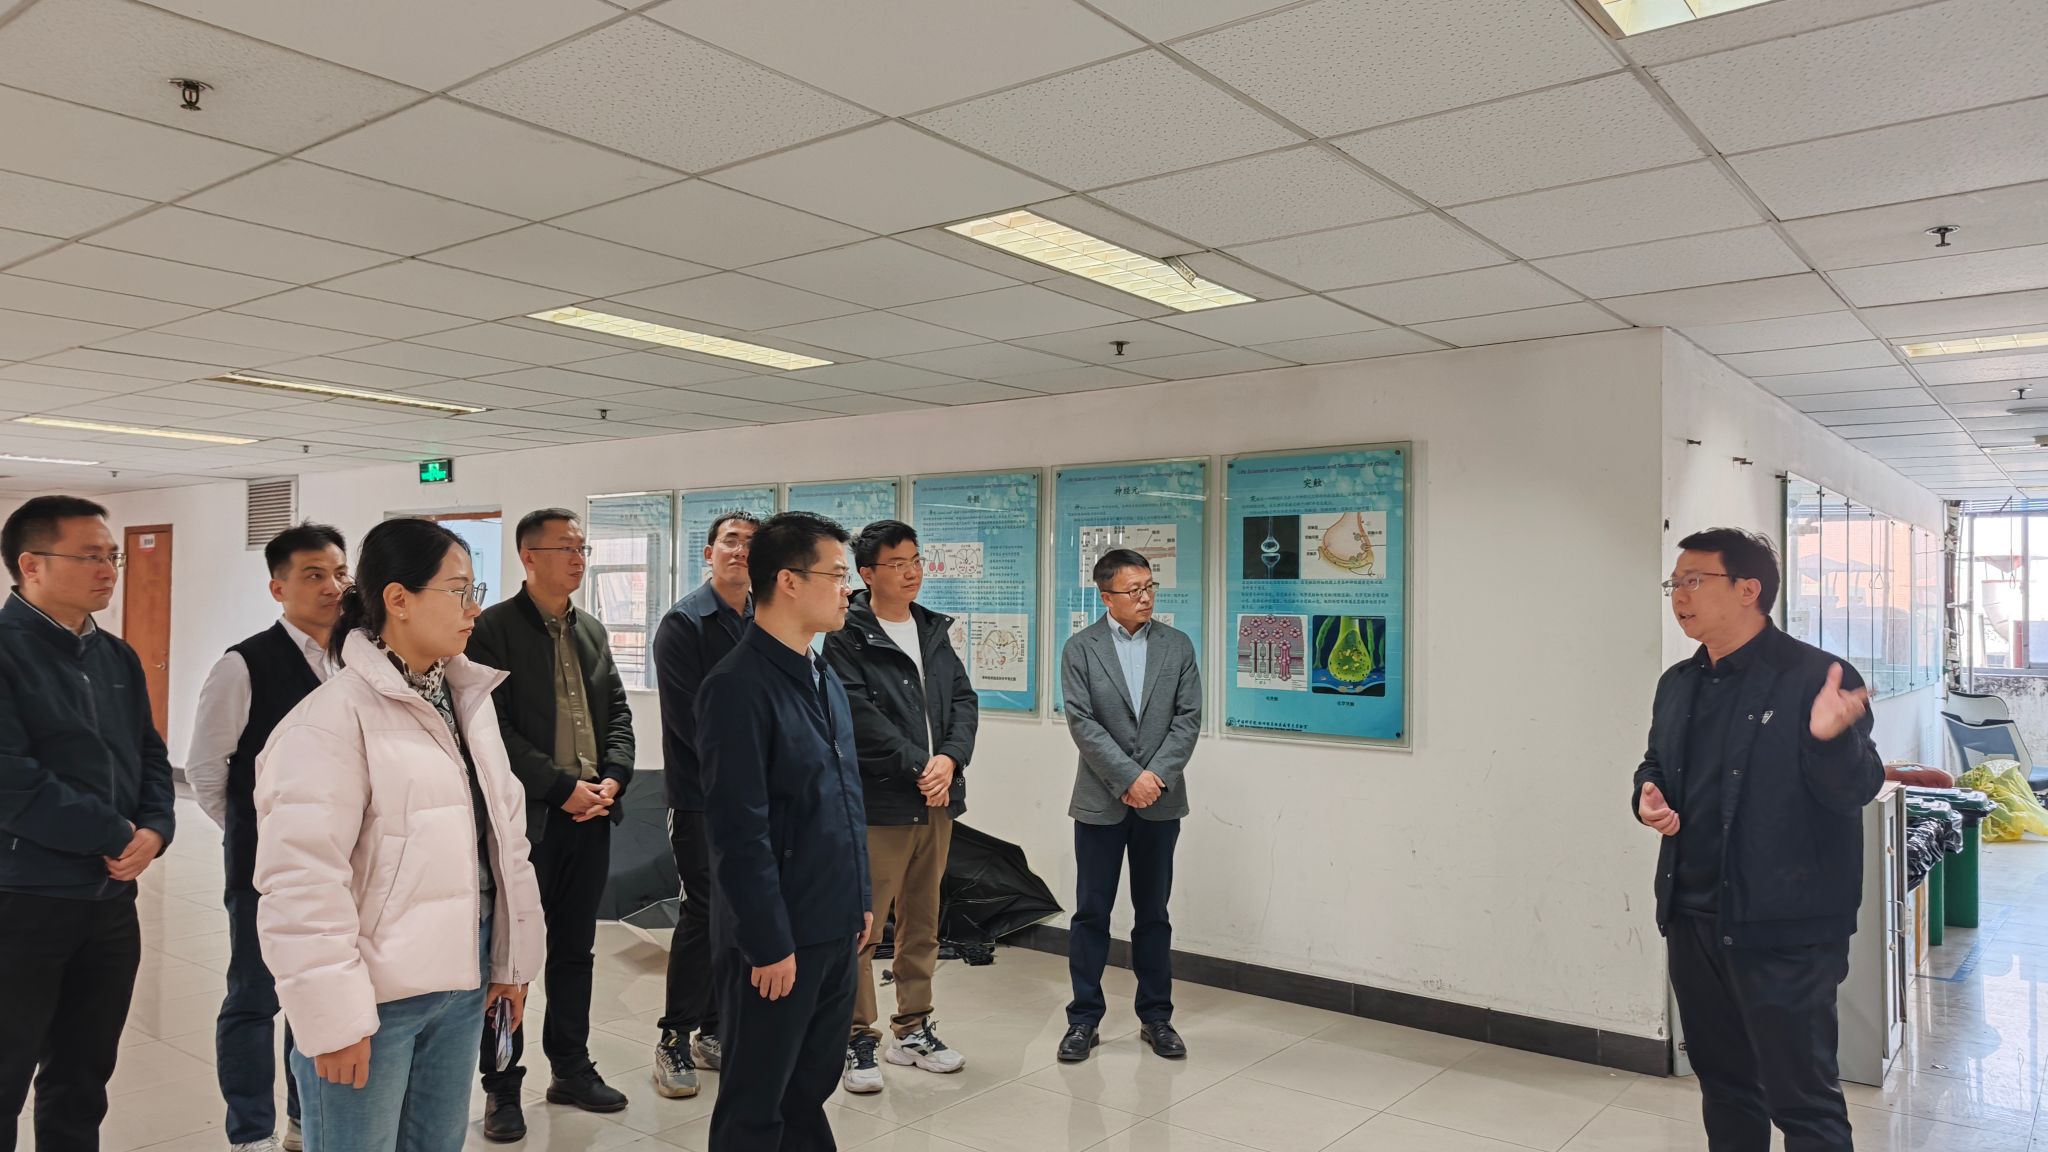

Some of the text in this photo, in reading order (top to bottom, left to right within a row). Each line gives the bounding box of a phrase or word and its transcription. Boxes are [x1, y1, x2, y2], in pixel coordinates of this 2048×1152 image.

[1303, 478, 1322, 489] 突触
[1114, 486, 1140, 496] 神经元
